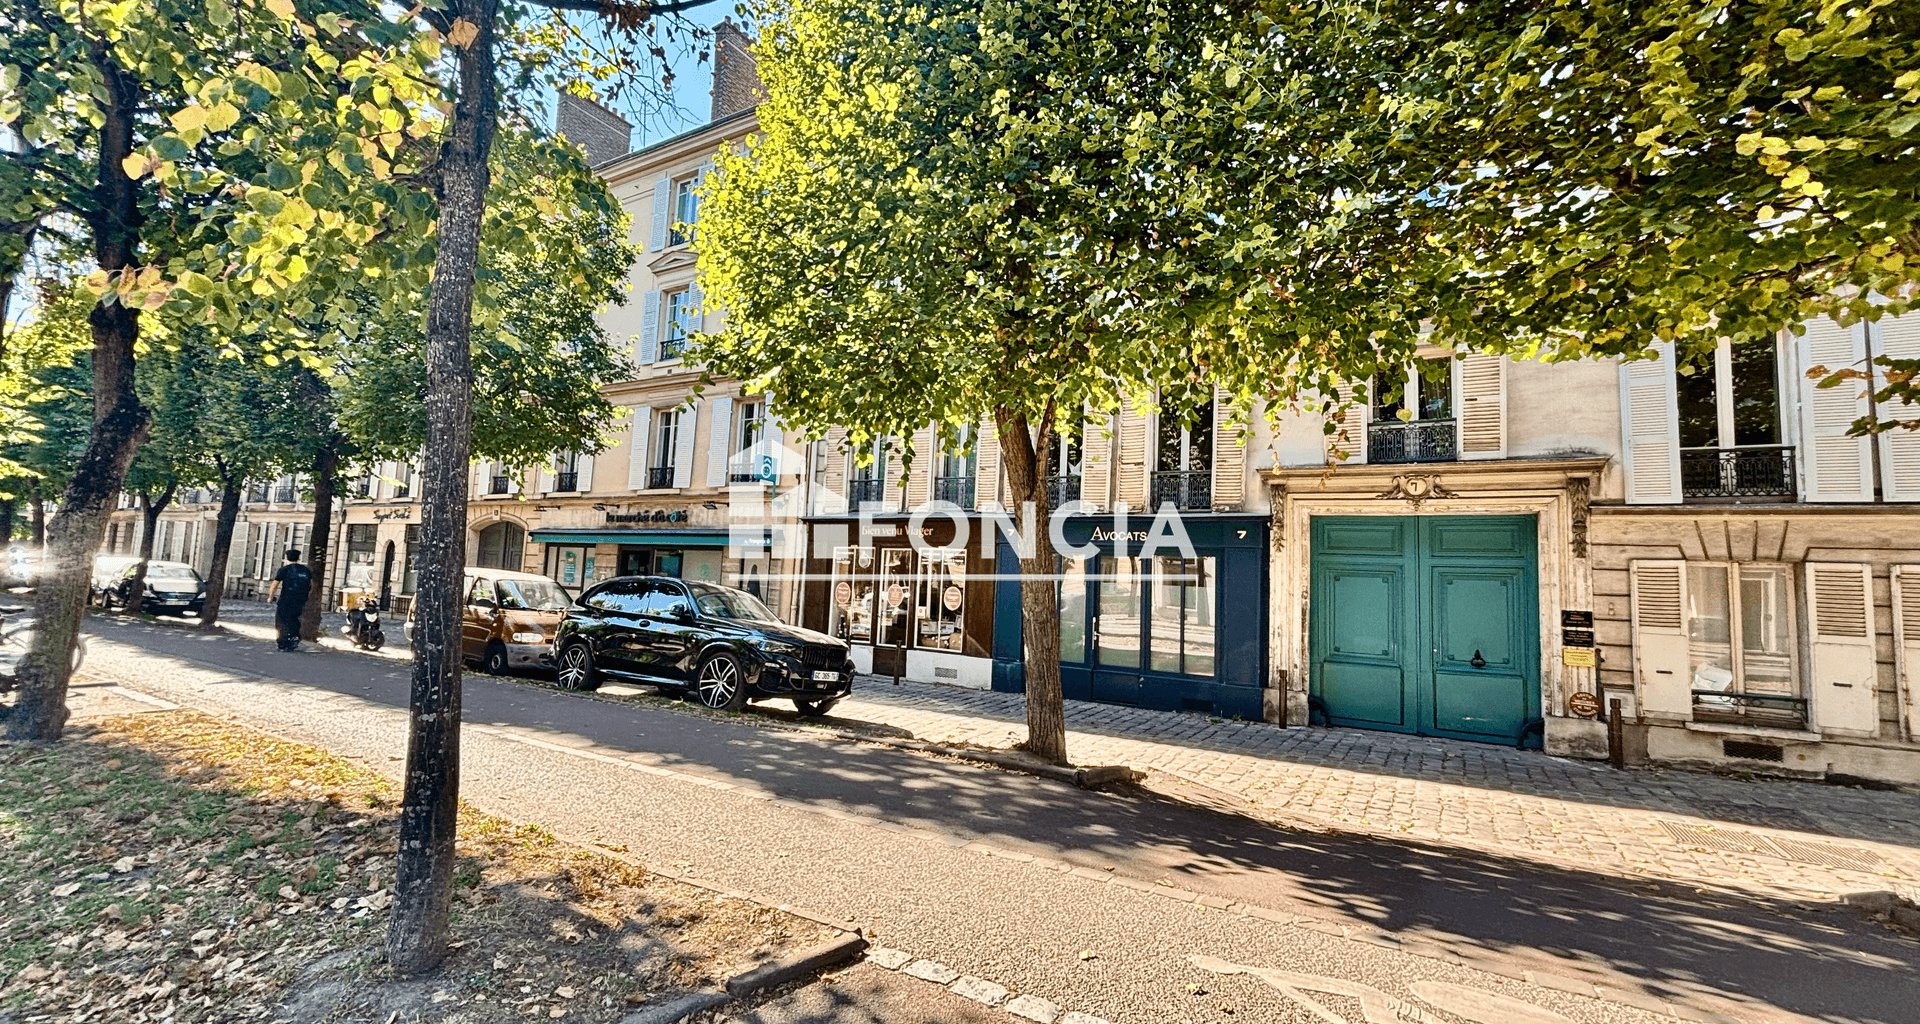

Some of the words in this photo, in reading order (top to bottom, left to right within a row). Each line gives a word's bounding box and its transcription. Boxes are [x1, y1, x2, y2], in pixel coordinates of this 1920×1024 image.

[1410, 482, 1418, 491] 7
[904, 525, 934, 539] Viager
[1007, 528, 1015, 537] 7
[1090, 526, 1148, 542] AVOCATS
[1236, 530, 1247, 539] 7
